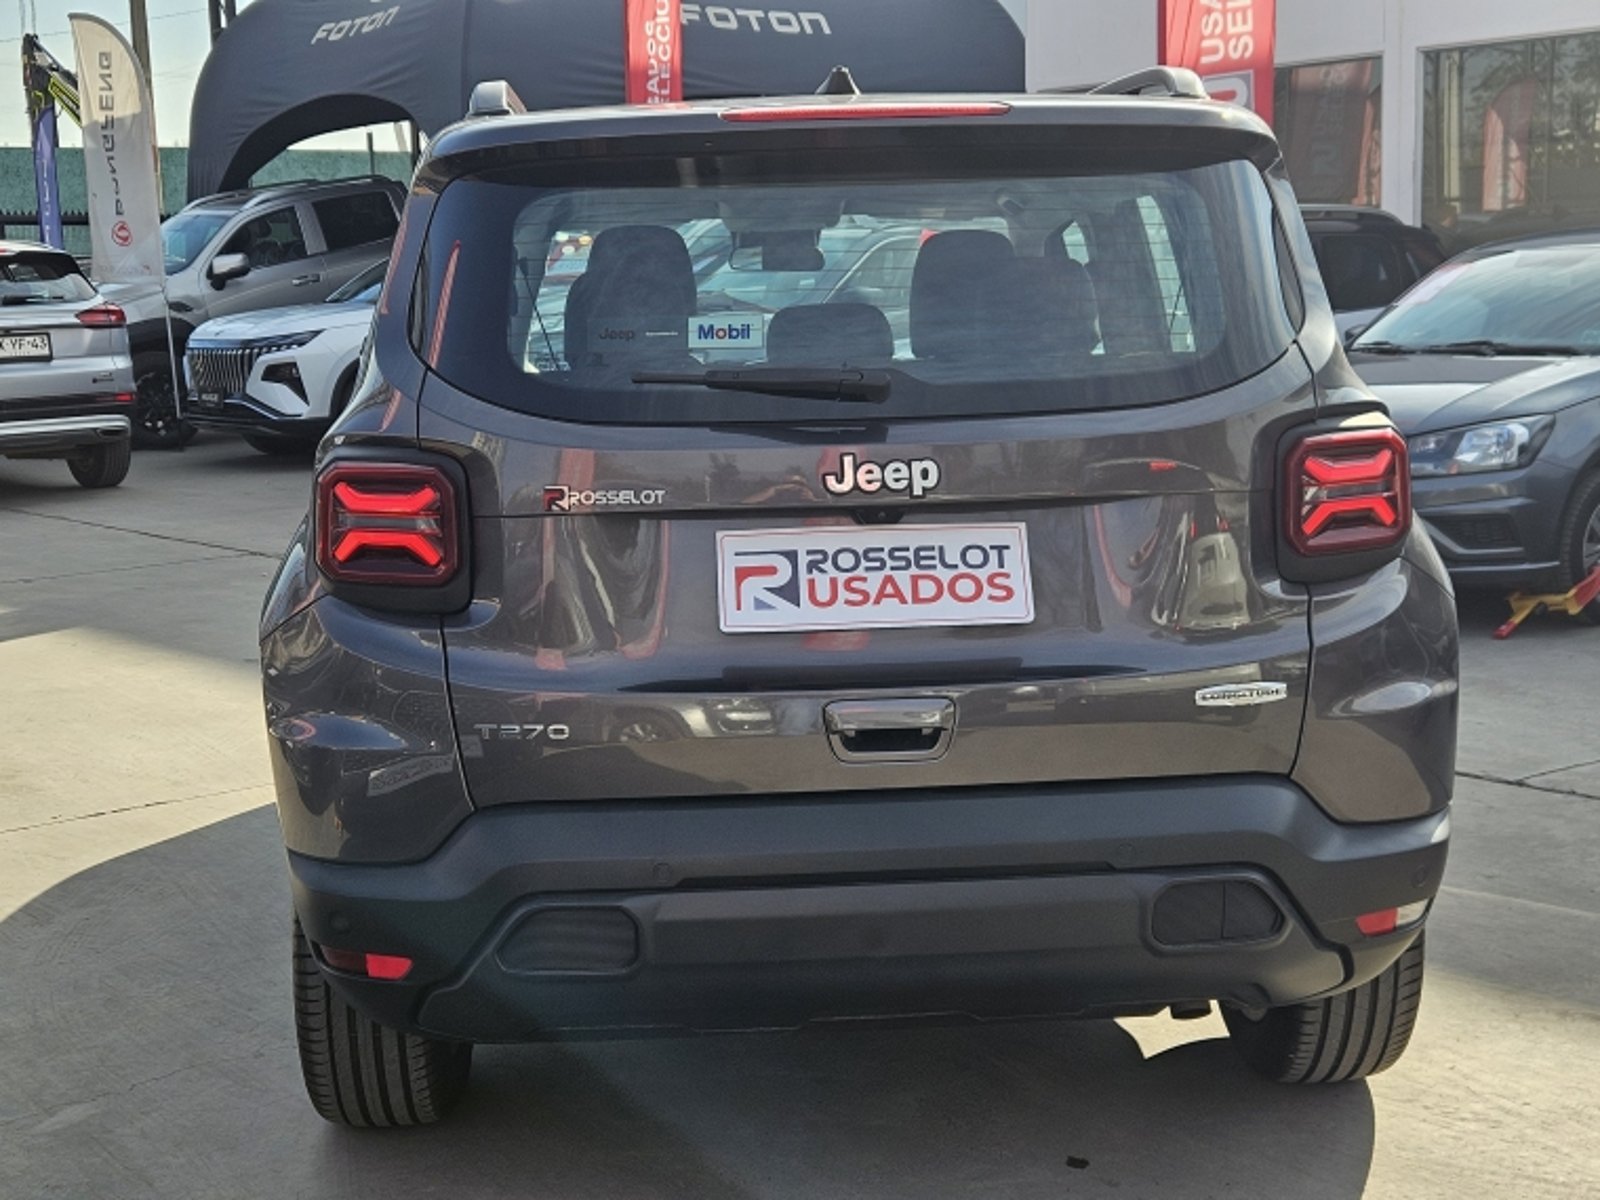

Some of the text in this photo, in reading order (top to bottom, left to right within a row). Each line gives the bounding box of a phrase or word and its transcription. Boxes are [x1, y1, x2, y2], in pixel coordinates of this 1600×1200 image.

[311, 5, 400, 45] FOTON
[681, 3, 832, 35] FOTON
[698, 323, 751, 341] Mobil
[824, 453, 940, 498] Jeep
[569, 489, 666, 506] ROSSELOT
[805, 544, 1011, 575] ROSSELOT
[806, 572, 1015, 608] USADOS
